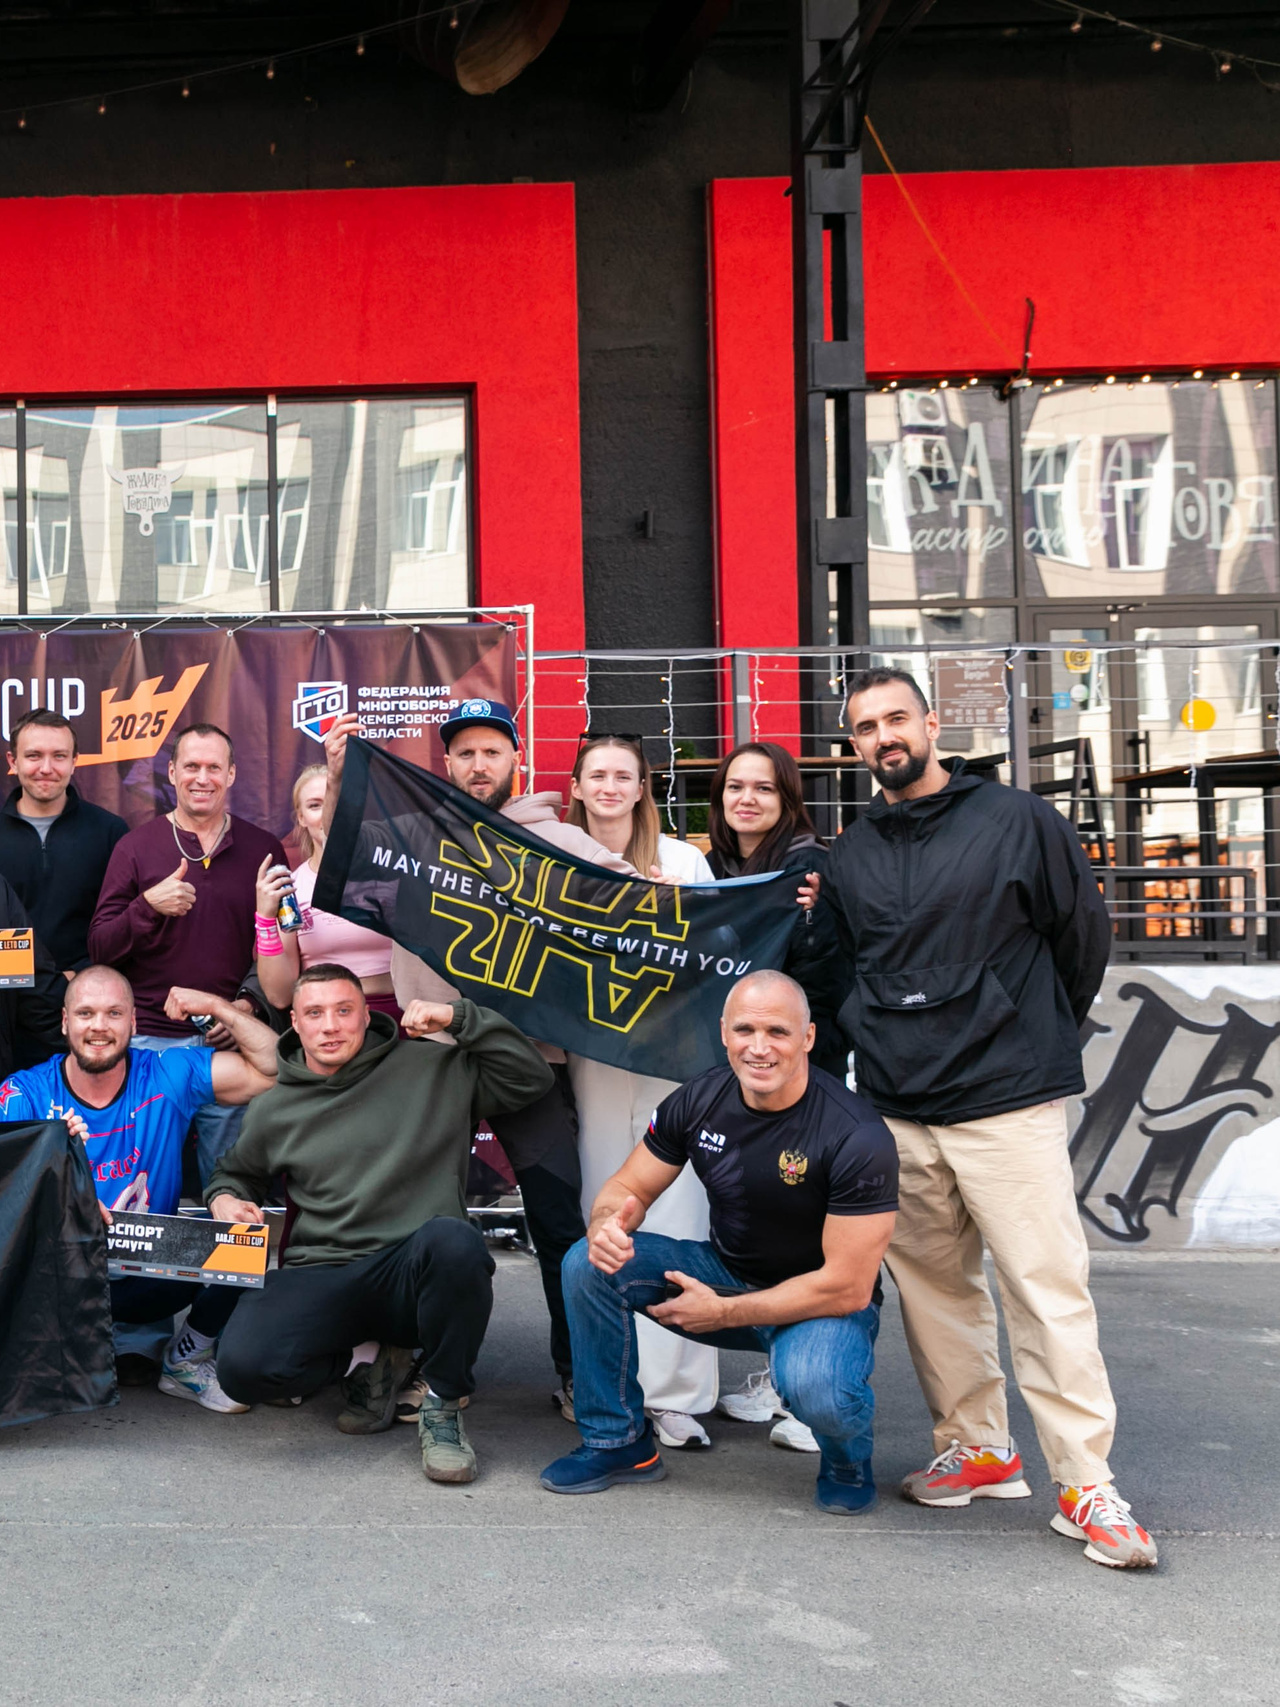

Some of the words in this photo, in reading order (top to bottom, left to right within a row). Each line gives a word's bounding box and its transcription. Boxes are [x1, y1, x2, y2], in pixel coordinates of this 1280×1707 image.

[357, 685, 451, 698] ФЕДЕРАЦИЯ
[299, 693, 342, 721] ГТО
[357, 699, 459, 712] МНОГОБОРЬЯ
[357, 713, 450, 725] КЕМЕРОВСКО
[106, 709, 168, 743] 2025
[358, 727, 422, 739] ОБЛАСТИ
[372, 846, 421, 877] MAY
[428, 865, 473, 895] THE
[573, 927, 608, 948] BE
[617, 937, 689, 967] WITH
[698, 953, 752, 976] YOU
[18, 940, 30, 949] CUP
[698, 1142, 724, 1153] SPORT
[215, 1233, 235, 1244] BABJE
[236, 1235, 250, 1245] LETO
[251, 1236, 264, 1246] CUP
